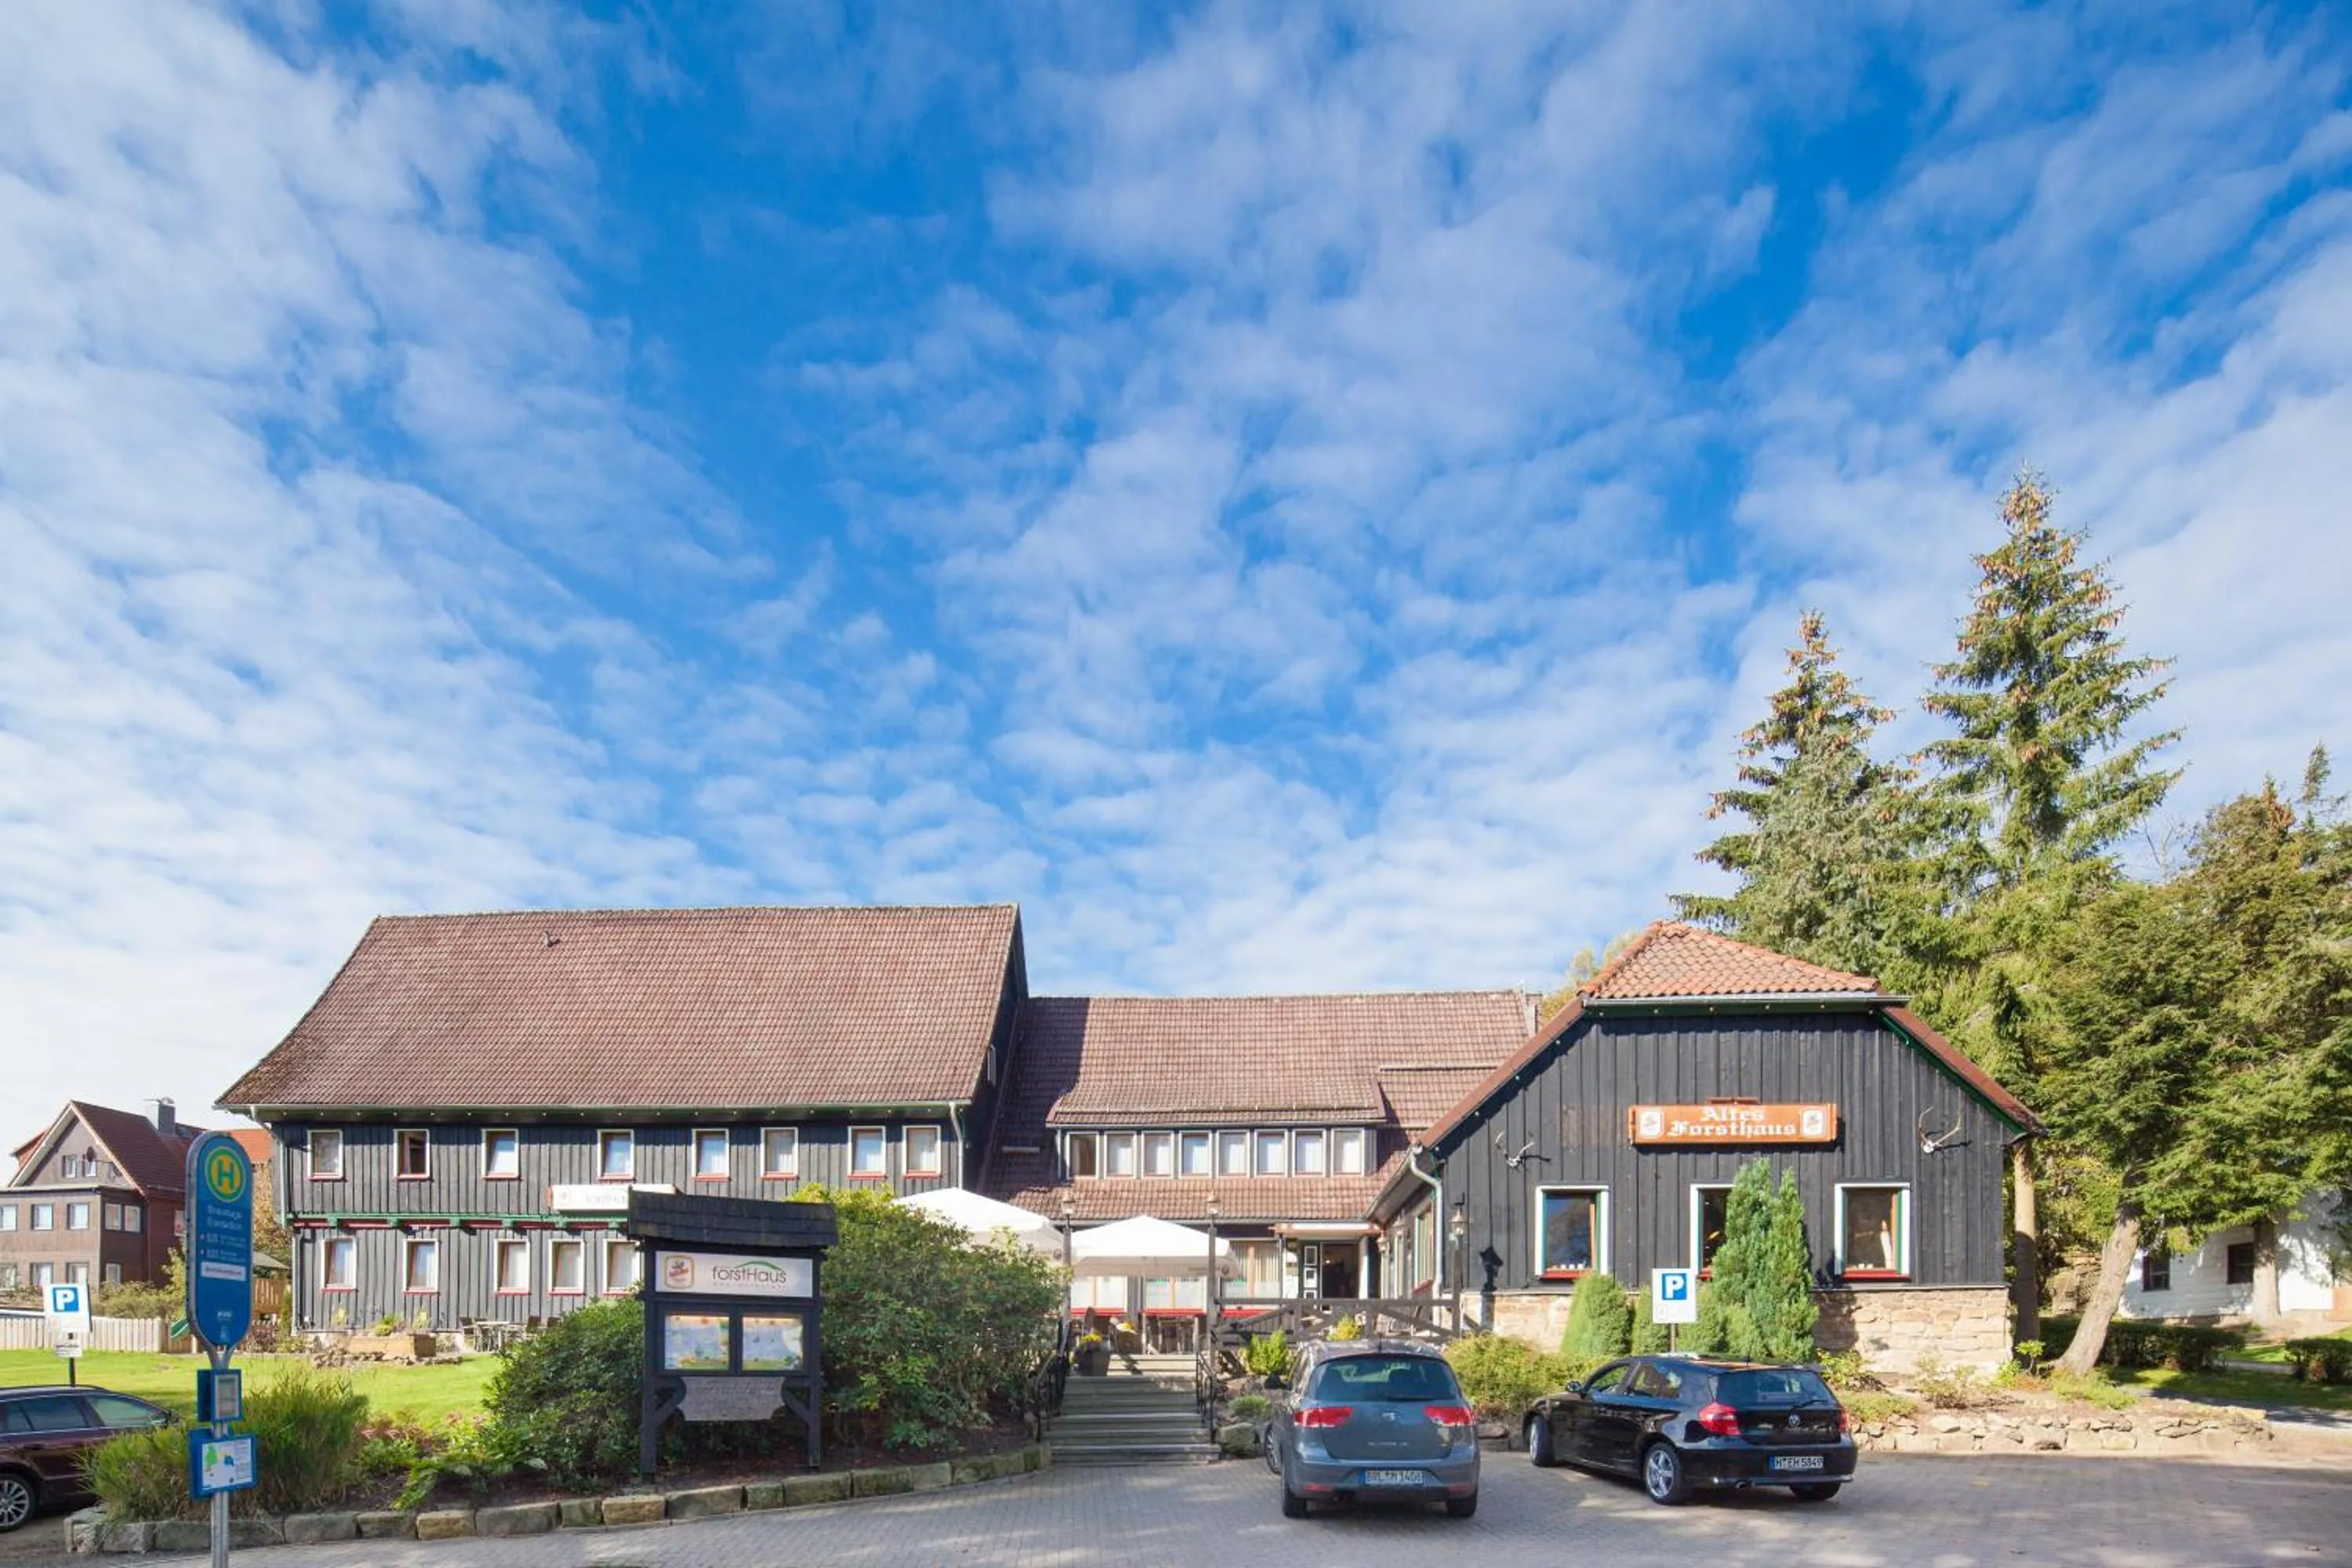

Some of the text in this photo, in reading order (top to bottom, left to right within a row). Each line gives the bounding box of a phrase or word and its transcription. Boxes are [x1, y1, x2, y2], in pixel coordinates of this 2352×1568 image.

[1700, 1106, 1766, 1122] Altes
[1667, 1120, 1796, 1138] Forsthaus
[218, 1161, 234, 1189] H
[1665, 1275, 1685, 1298] P
[56, 1290, 75, 1310] P
